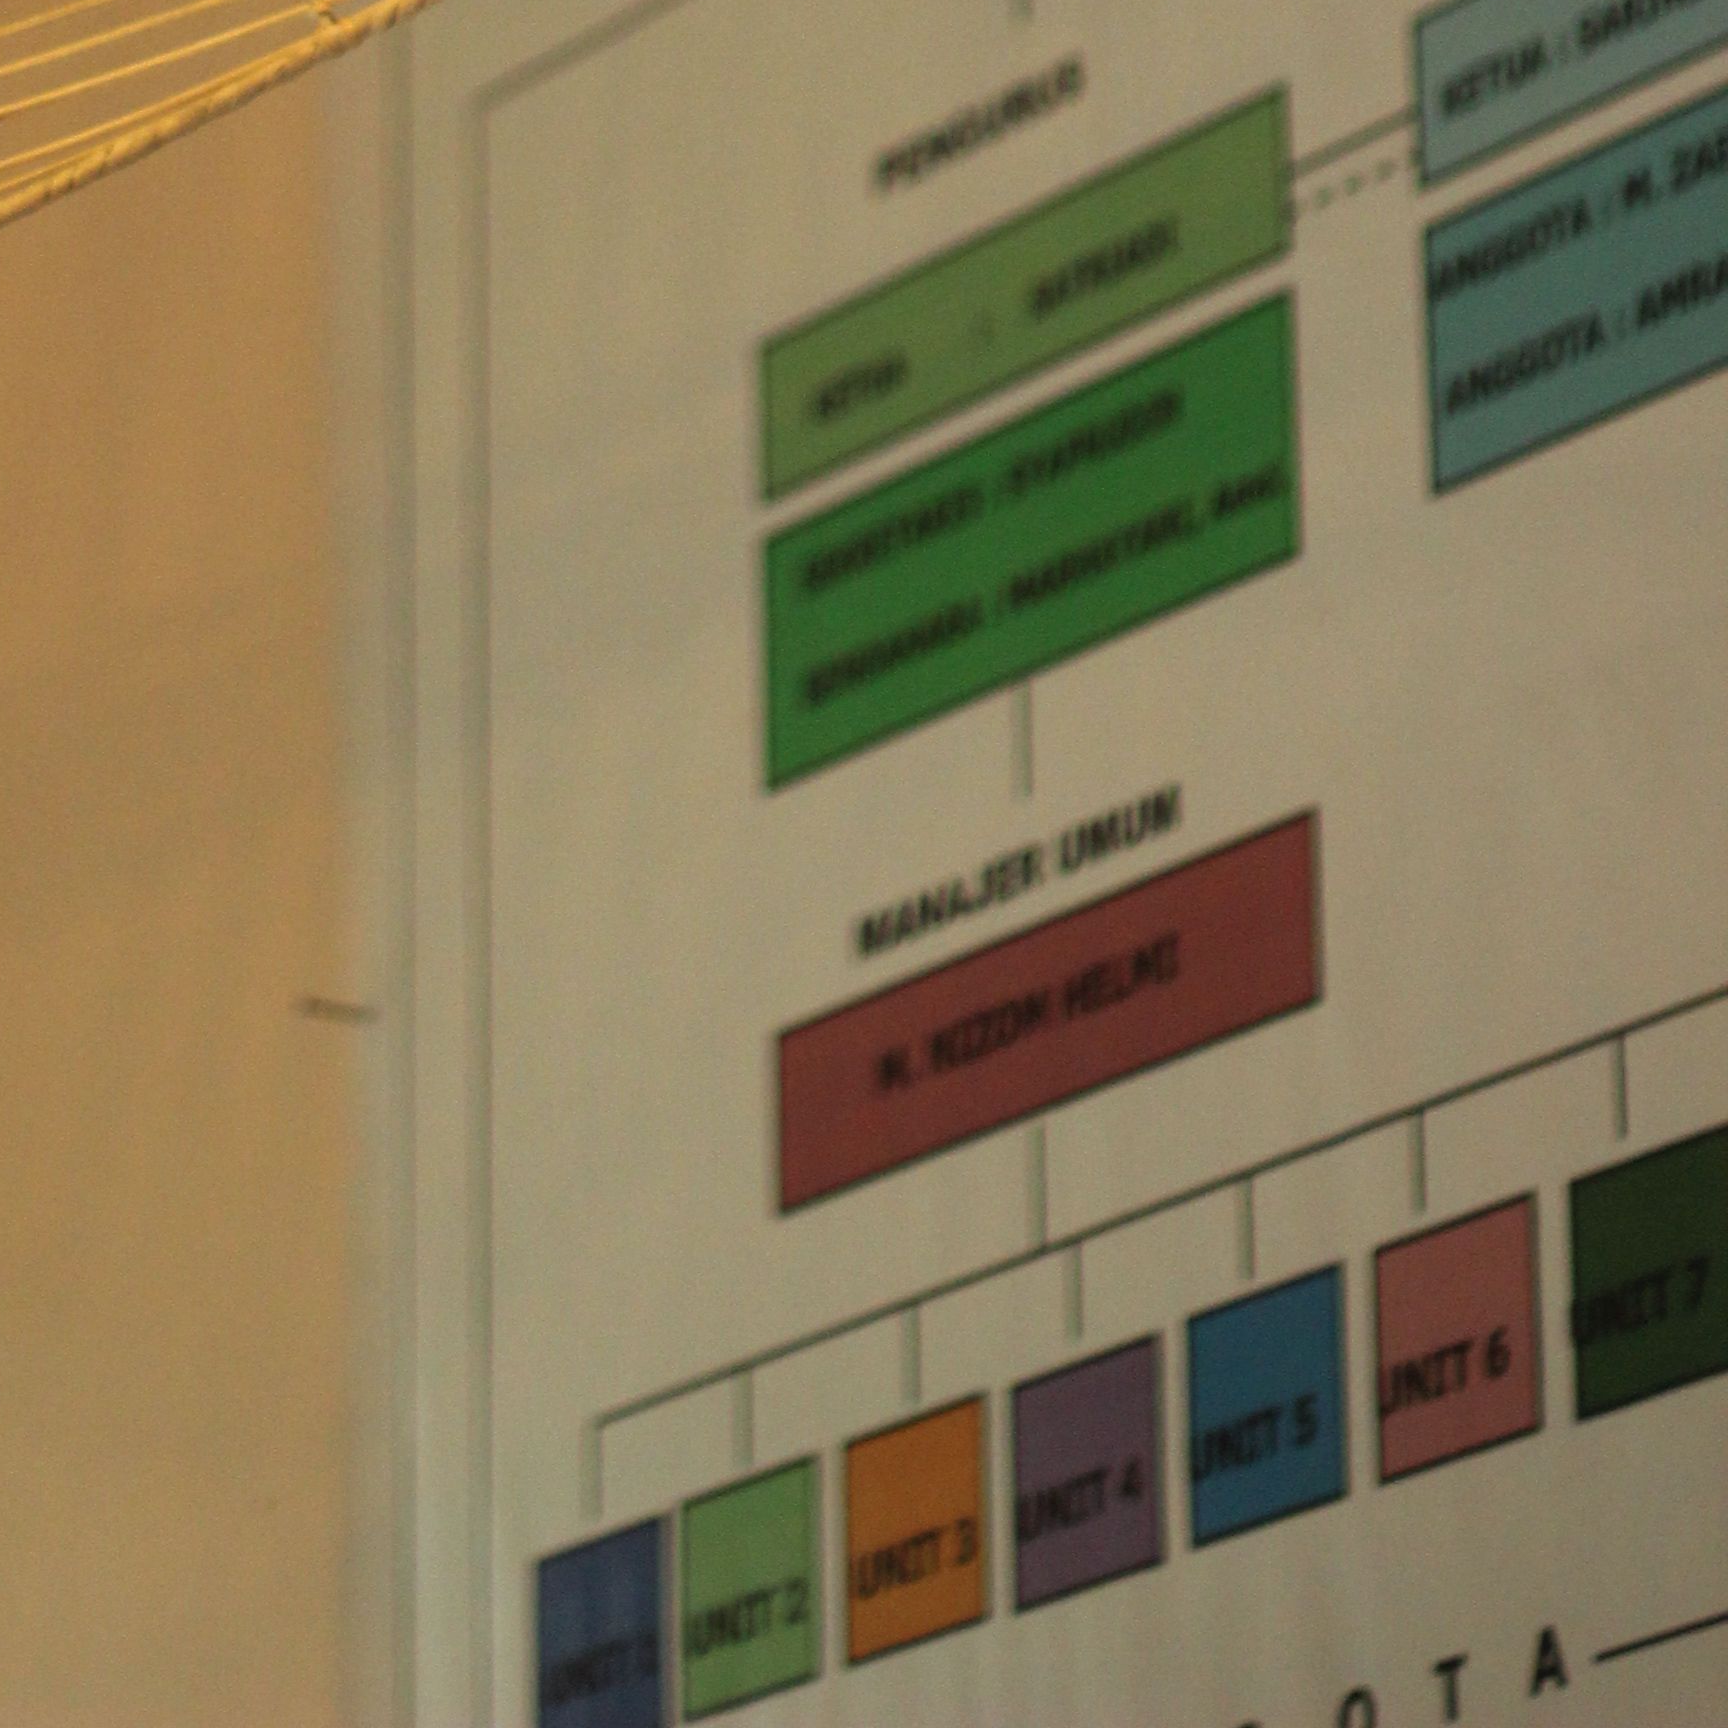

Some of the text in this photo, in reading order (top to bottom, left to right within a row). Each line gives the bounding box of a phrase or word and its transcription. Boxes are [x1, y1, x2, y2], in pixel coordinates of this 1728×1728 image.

[1429, 198, 1592, 302] ANGGOTA
[1446, 308, 1606, 416] ANGGOTA
[857, 784, 1180, 957] MANAJER UMUM
[1378, 1325, 1509, 1417] UNIT 6
[1191, 1404, 1282, 1481] UNIT
[1018, 1465, 1110, 1546] UNIT
[856, 1524, 948, 1600] UNIT
[684, 1586, 776, 1656] UNIT
